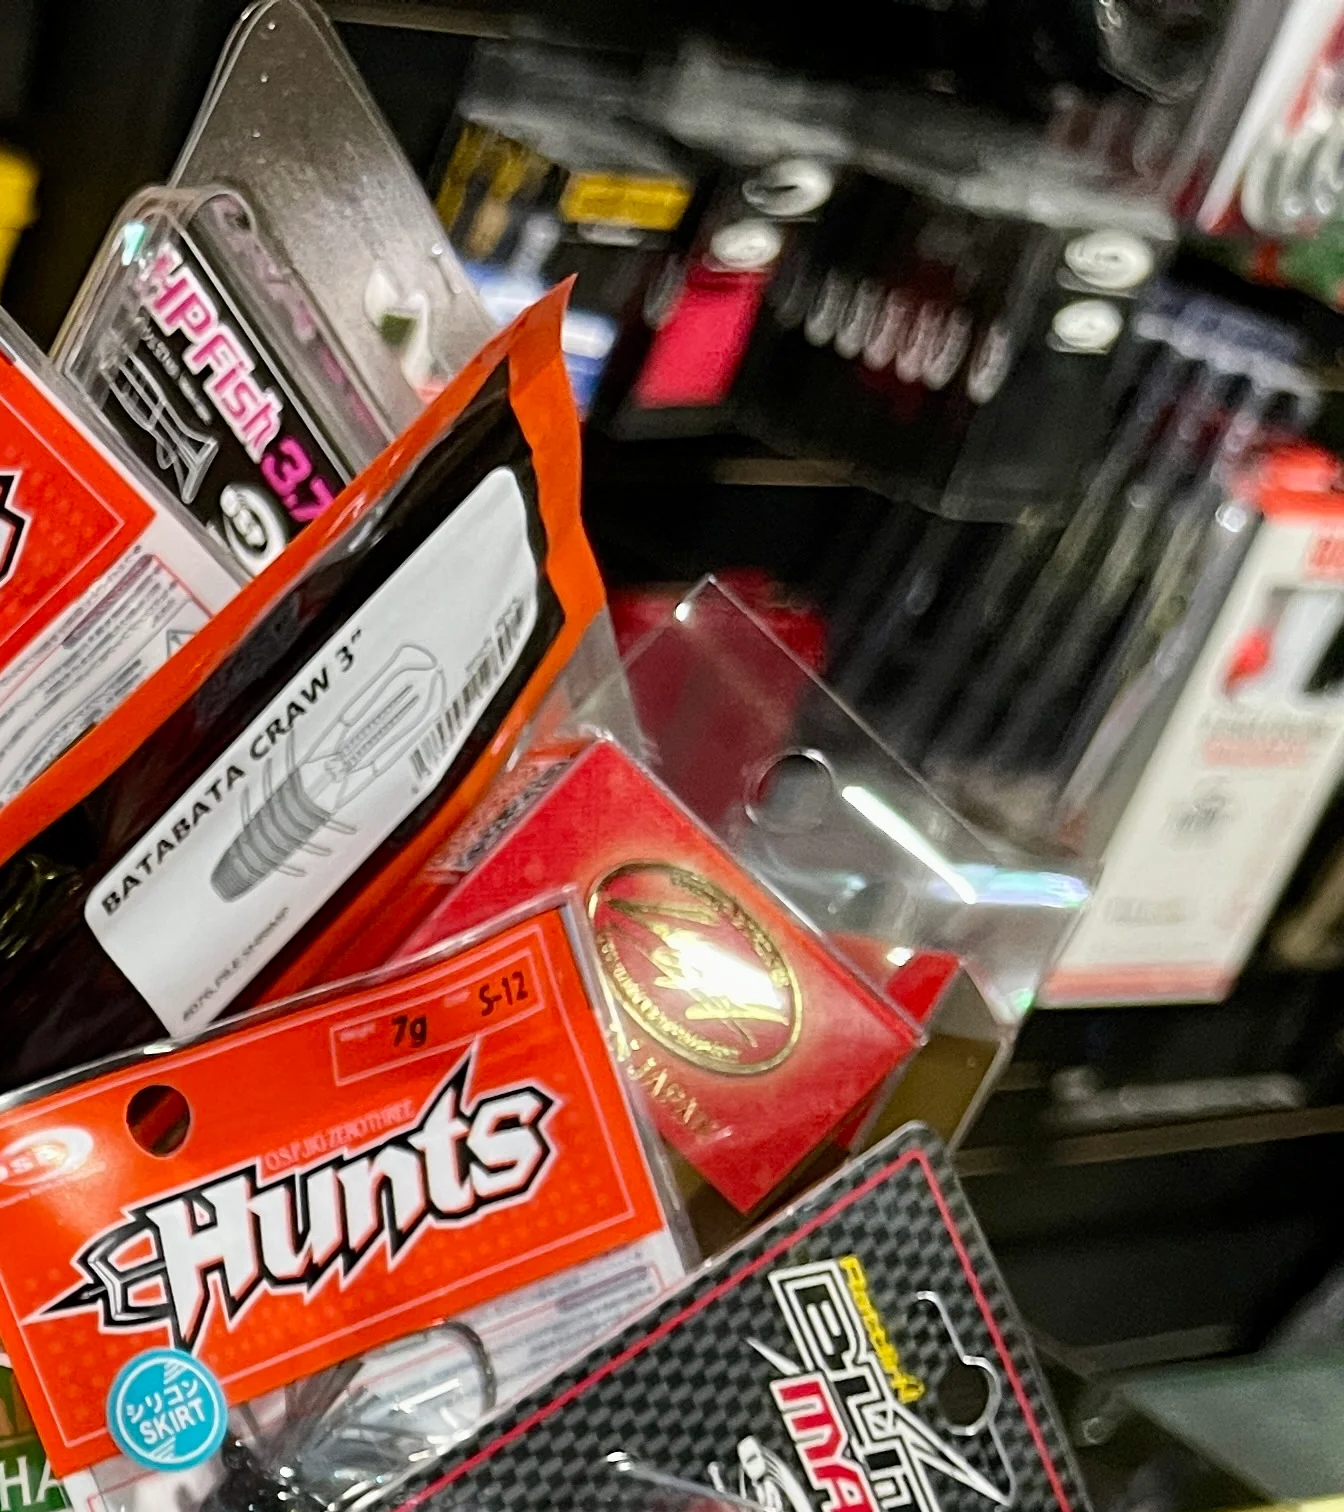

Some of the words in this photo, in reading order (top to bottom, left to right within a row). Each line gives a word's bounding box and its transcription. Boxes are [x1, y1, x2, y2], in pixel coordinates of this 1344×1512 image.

[100, 763, 246, 917] BATABATA
[250, 674, 332, 760] CRAW
[478, 971, 530, 1018] S-12
[389, 1016, 430, 1049] 7g
[82, 1035, 562, 1353] Hunts
[124, 1376, 203, 1428] シリコン
[137, 1402, 207, 1444] SKIRT
